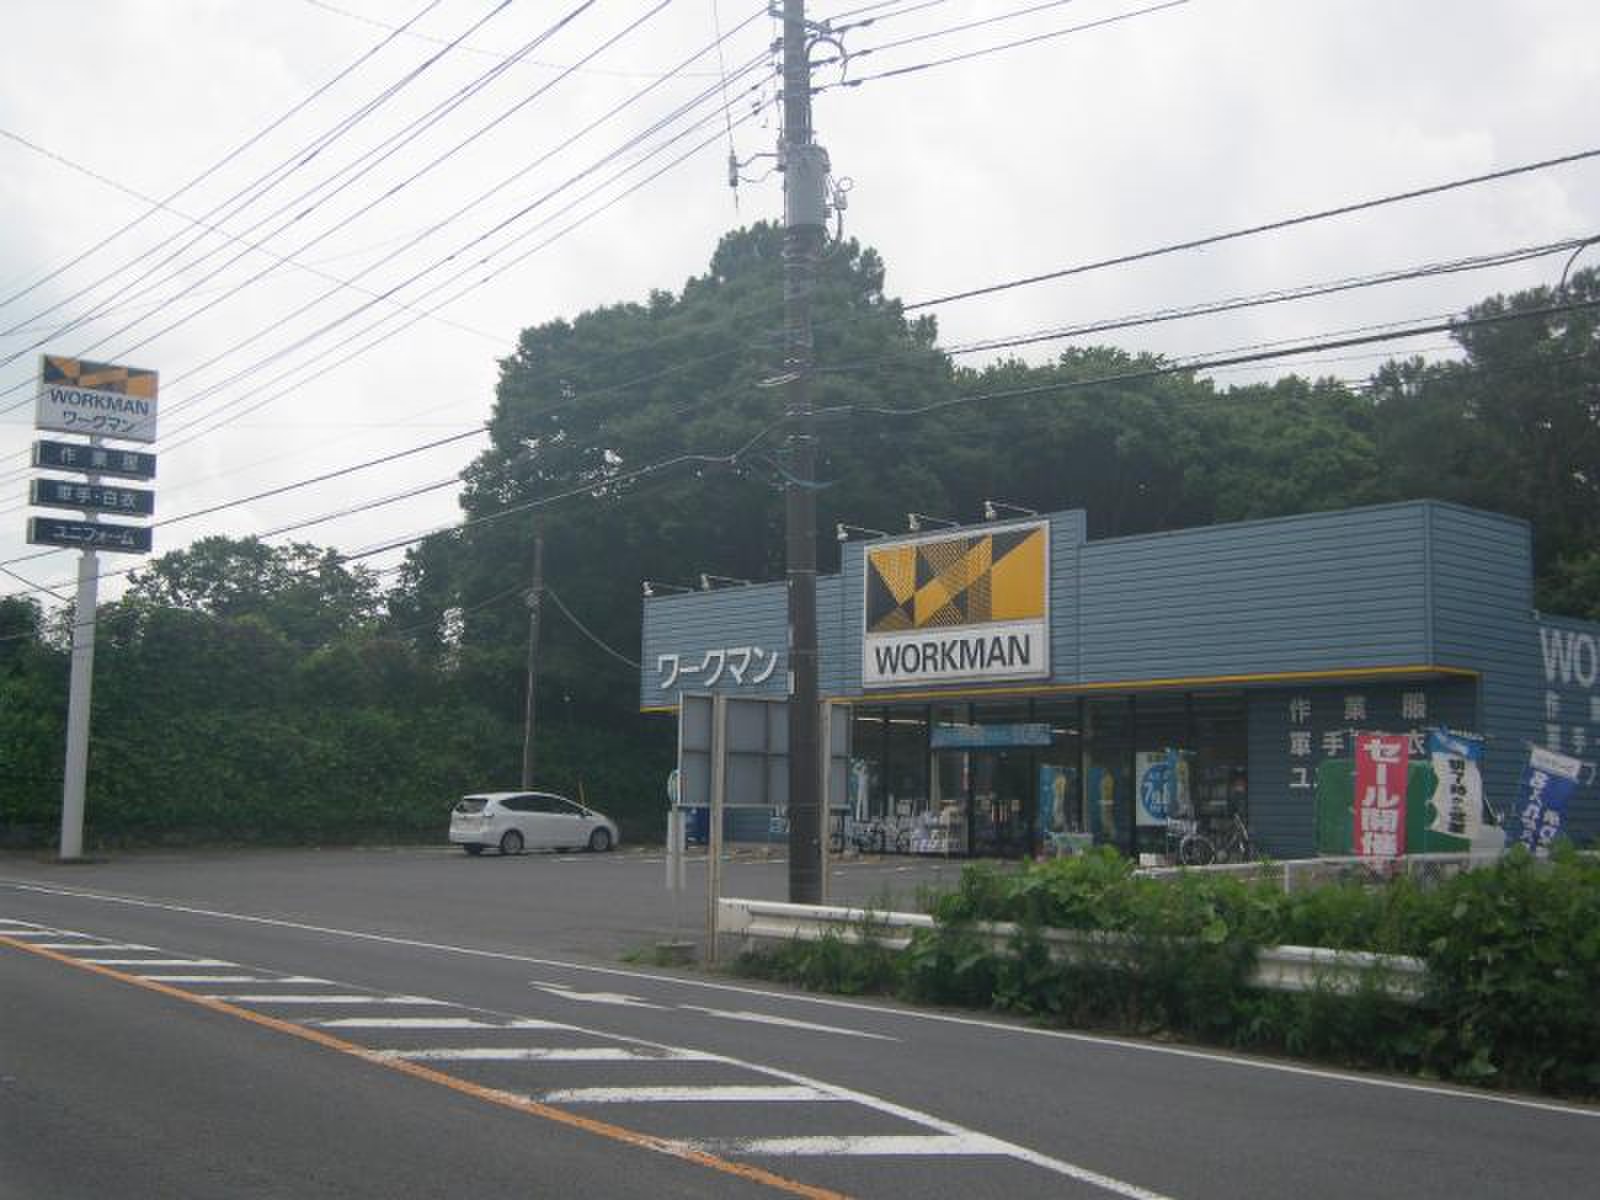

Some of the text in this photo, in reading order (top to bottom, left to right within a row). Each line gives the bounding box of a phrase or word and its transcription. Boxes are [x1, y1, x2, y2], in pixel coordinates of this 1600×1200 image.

[50, 387, 149, 416] WORKMAN
[63, 410, 138, 432] ワークマン
[657, 646, 778, 688] ワークマン
[875, 634, 1031, 674] WORKMAN
[1539, 627, 1600, 688] WO
